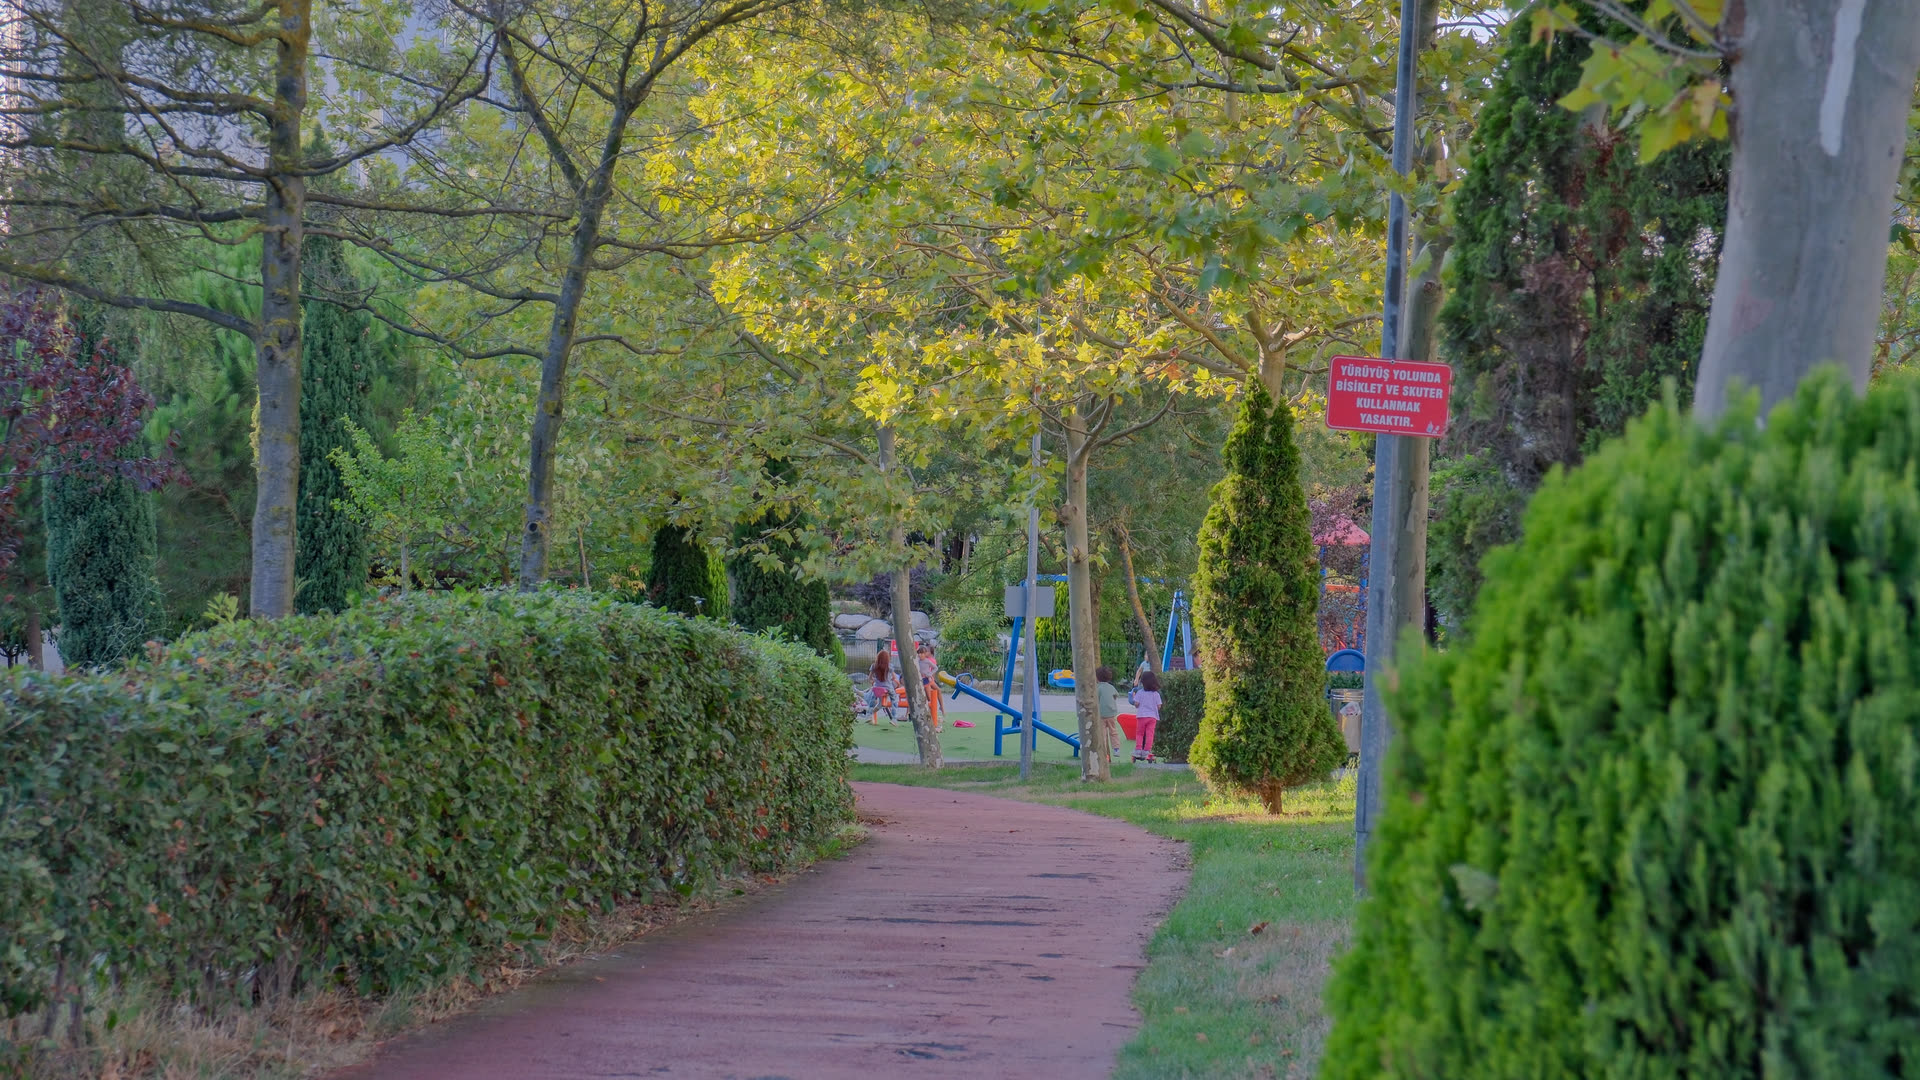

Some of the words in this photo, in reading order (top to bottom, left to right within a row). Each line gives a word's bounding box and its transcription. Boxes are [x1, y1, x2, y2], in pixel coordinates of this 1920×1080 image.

[1340, 363, 1390, 382] YÜRÜYÜŞ
[1393, 369, 1441, 383] YOLUNDA
[1336, 378, 1383, 394] BİSİKLET
[1386, 384, 1400, 395] VE
[1402, 386, 1443, 399] SKUTER
[1356, 397, 1420, 412] KULLANMAK
[1360, 413, 1414, 427] YASAKTIR.
